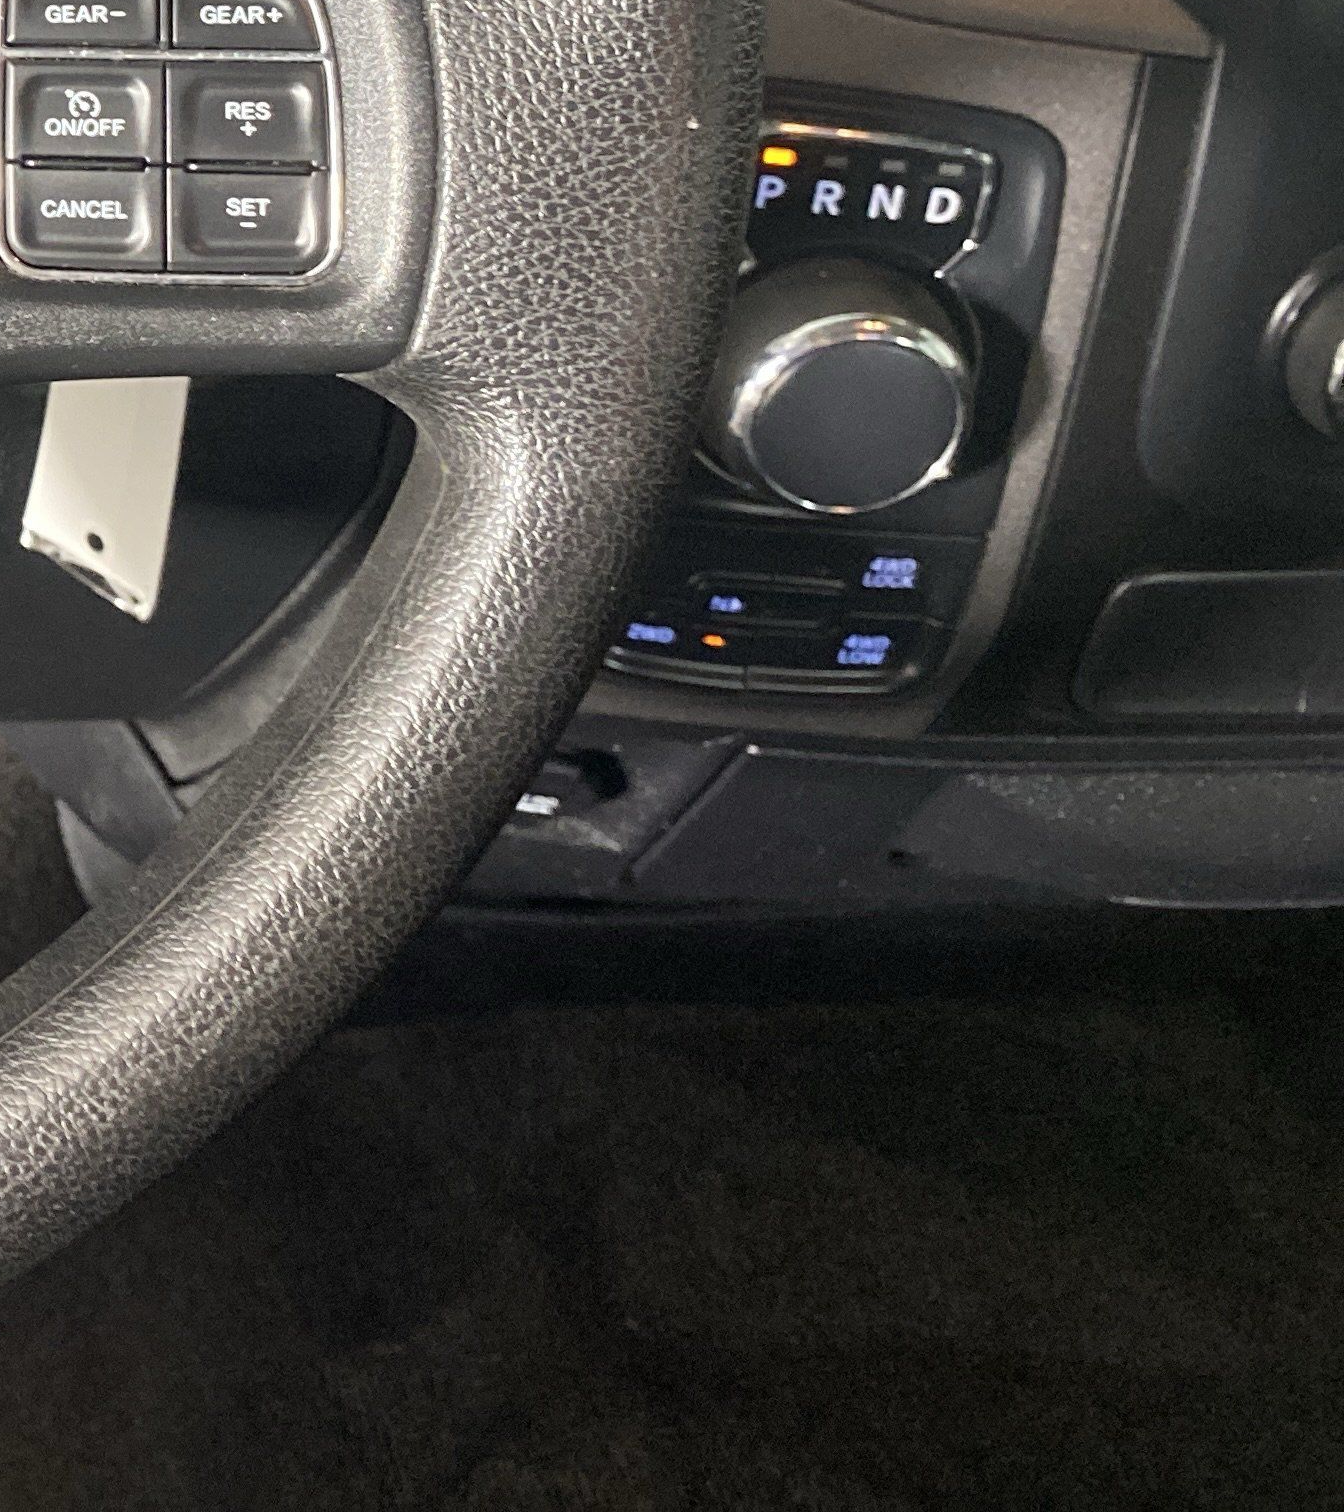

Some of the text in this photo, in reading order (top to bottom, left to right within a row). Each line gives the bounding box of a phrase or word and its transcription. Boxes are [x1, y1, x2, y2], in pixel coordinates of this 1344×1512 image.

[224, 102, 272, 121] RES
[44, 118, 126, 137] ON/OFF
[226, 198, 271, 217] SET
[754, 174, 963, 224] P R N D
[40, 199, 129, 220] CANCEL
